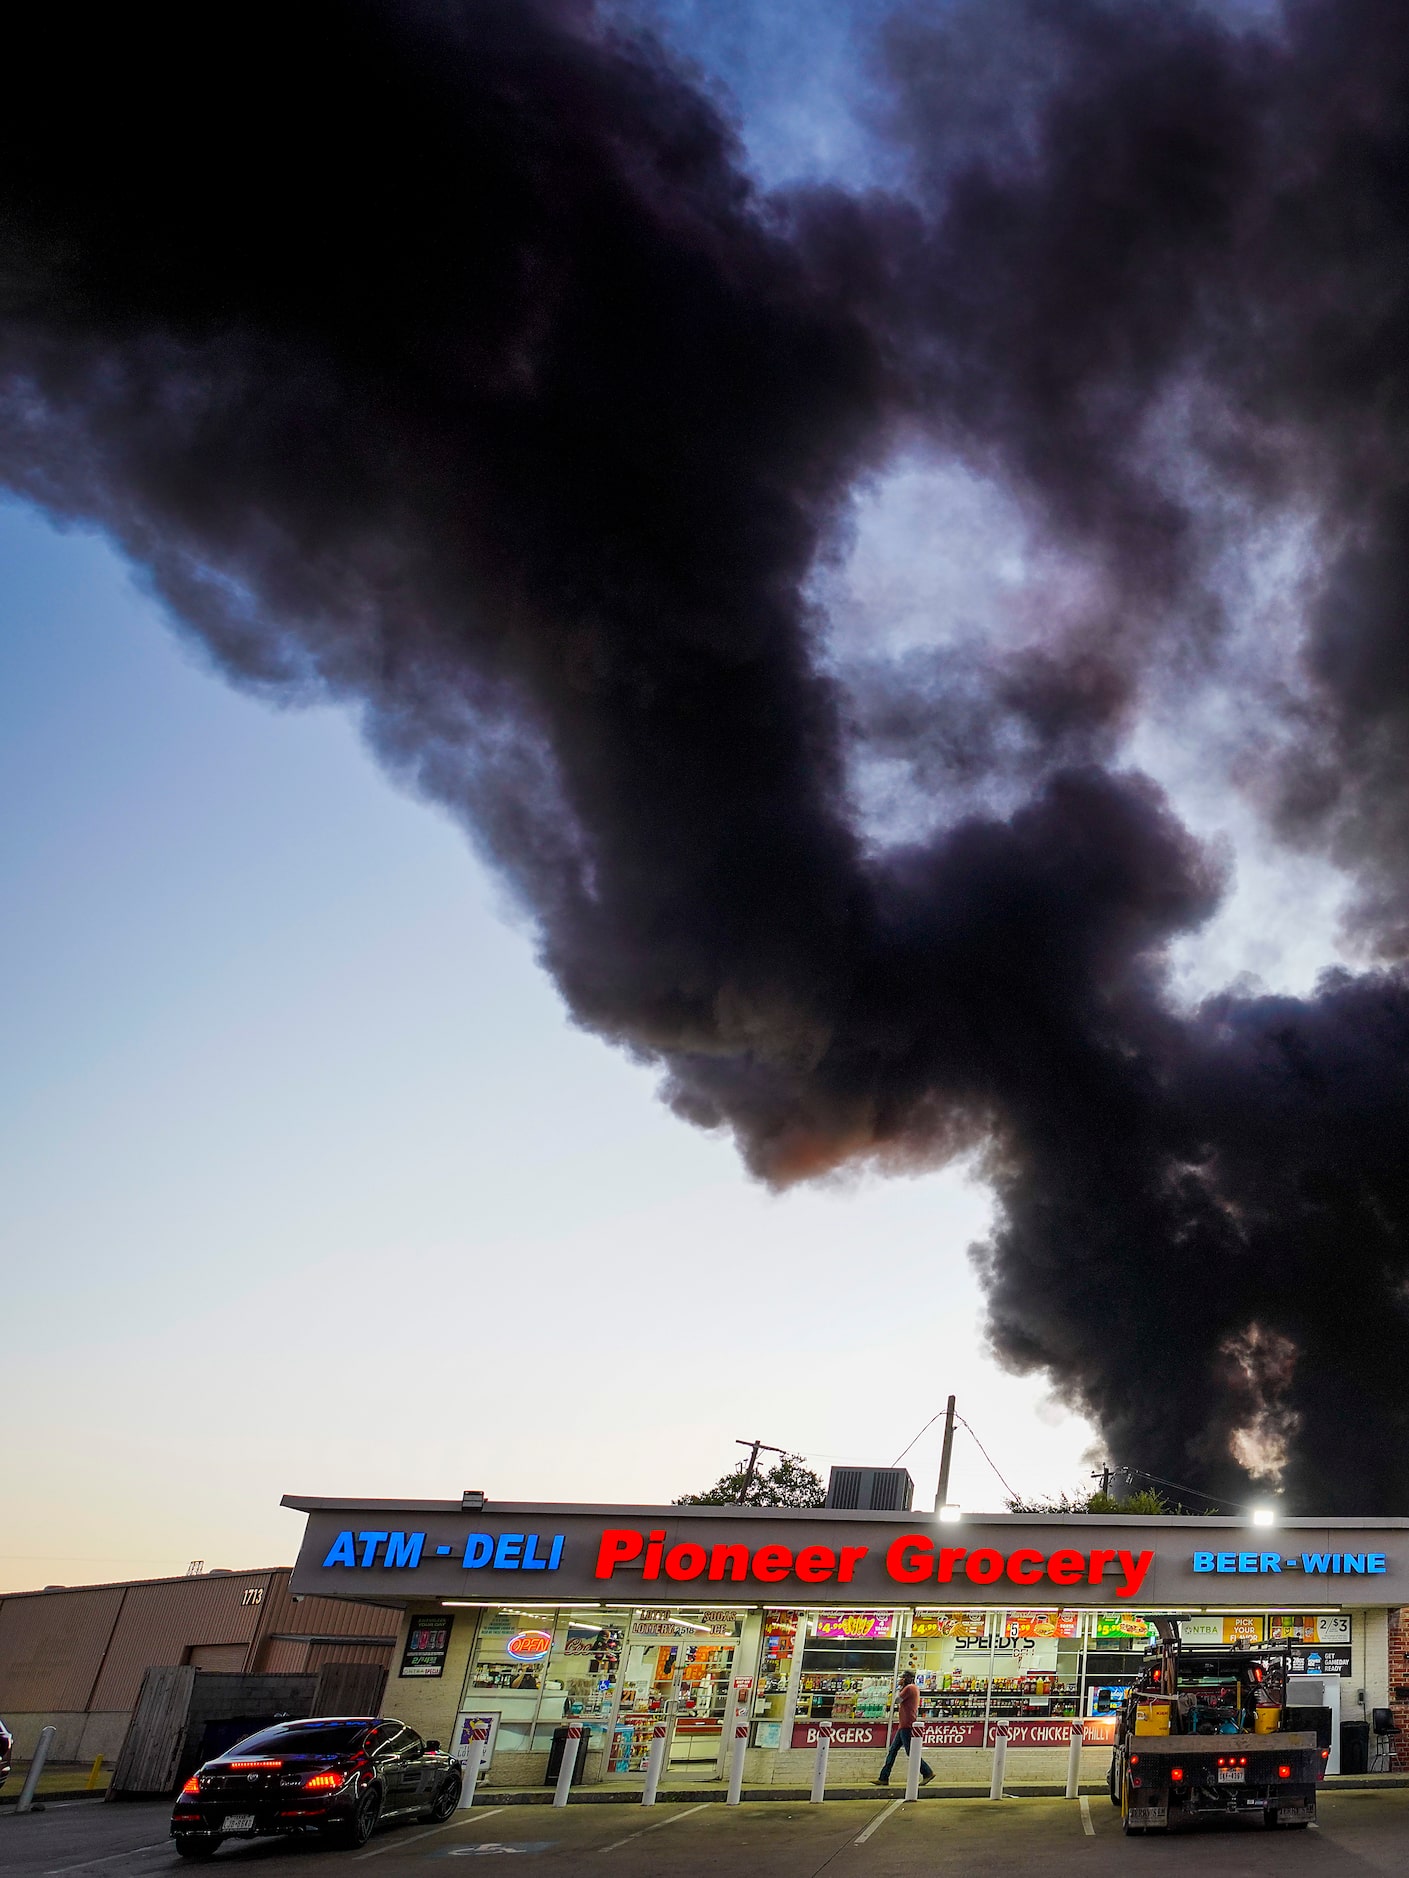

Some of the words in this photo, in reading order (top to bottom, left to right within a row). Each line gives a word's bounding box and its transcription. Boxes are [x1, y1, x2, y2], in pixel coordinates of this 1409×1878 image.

[322, 1531, 426, 1568] ATM
[462, 1533, 565, 1569] DELI
[595, 1529, 869, 1583] Pioneer
[886, 1533, 1155, 1598] Grocery
[241, 1588, 264, 1605] 1713
[703, 1610, 737, 1622] SODAS
[1235, 1618, 1254, 1626] PICK
[632, 1623, 675, 1634] LOTTERY
[710, 1624, 727, 1635] ICE
[913, 1623, 938, 1634] $4.99
[1233, 1626, 1255, 1634] YOUR
[509, 1637, 550, 1652] OPEN
[955, 1636, 1036, 1649] SPEEDYS
[1324, 1665, 1343, 1673] READY
[806, 1727, 873, 1743] BRGERS
[988, 1726, 1027, 1742] CSPY
